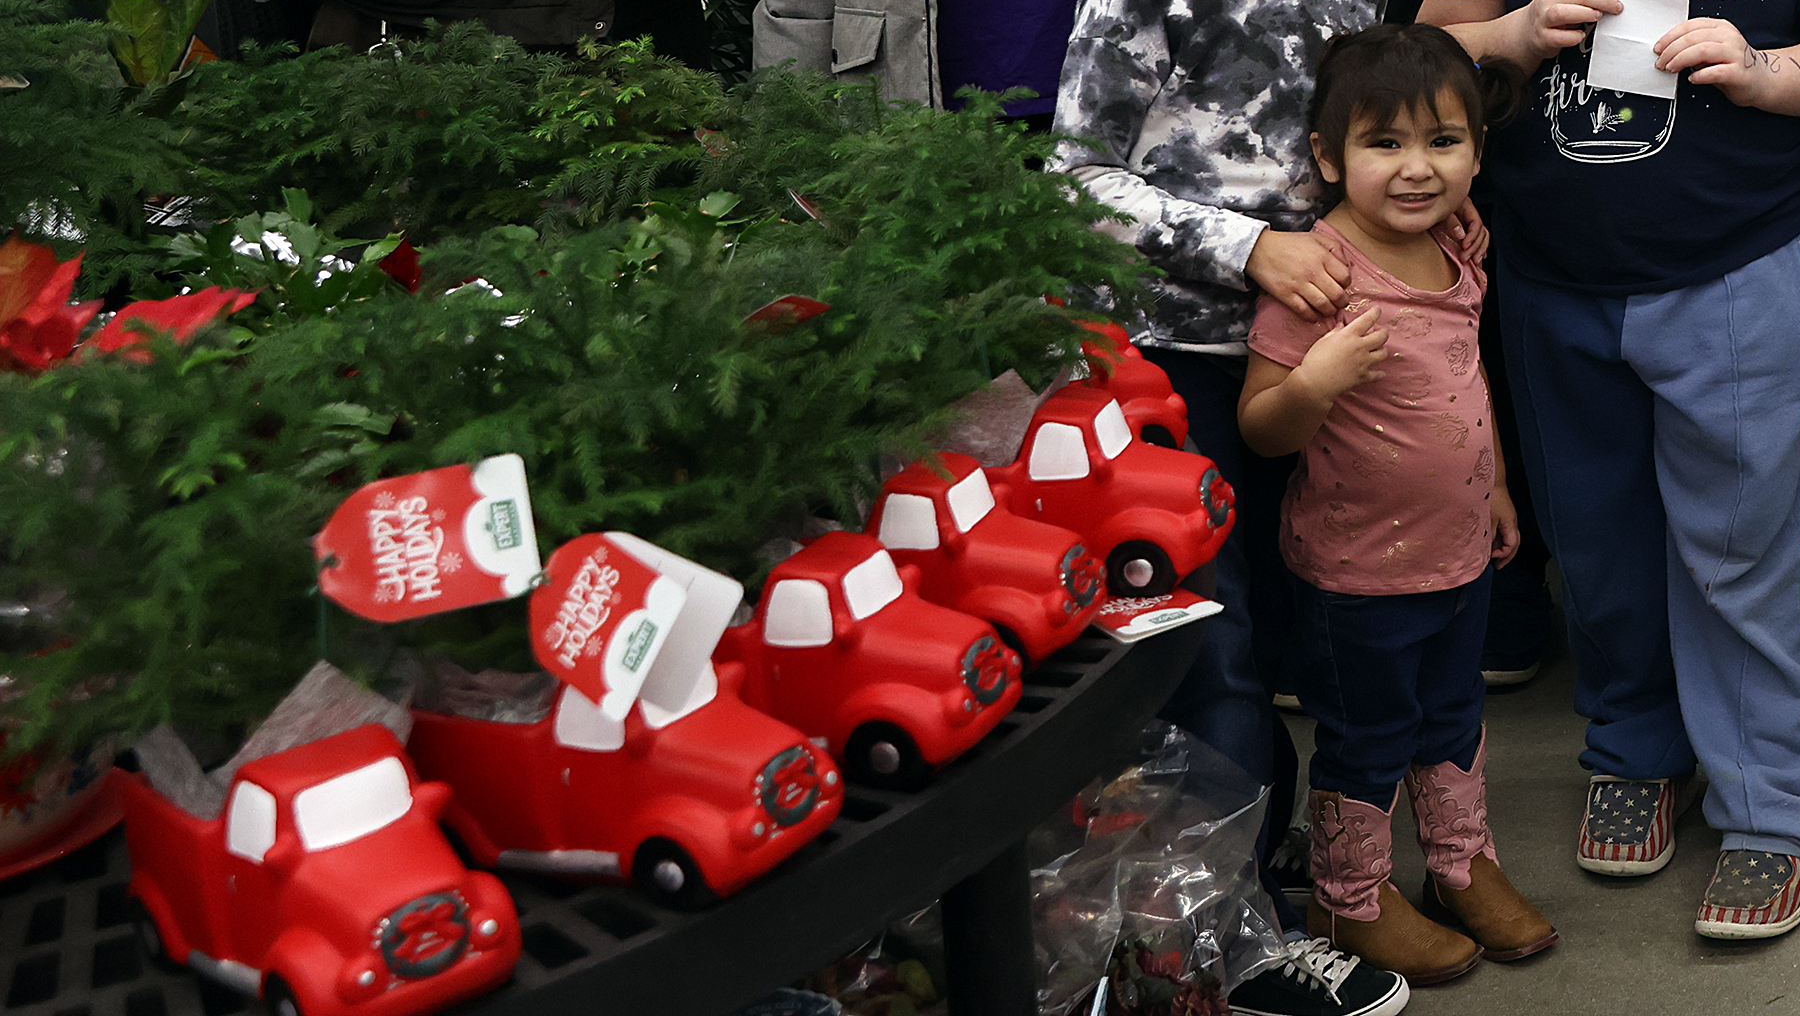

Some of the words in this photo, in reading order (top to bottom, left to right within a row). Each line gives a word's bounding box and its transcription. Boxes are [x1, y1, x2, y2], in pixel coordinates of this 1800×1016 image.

[369, 507, 409, 602] HAPPY
[400, 495, 445, 602] HOLIDAYS
[553, 555, 602, 649] HAPPY
[558, 565, 620, 668] HOLIDAYS
